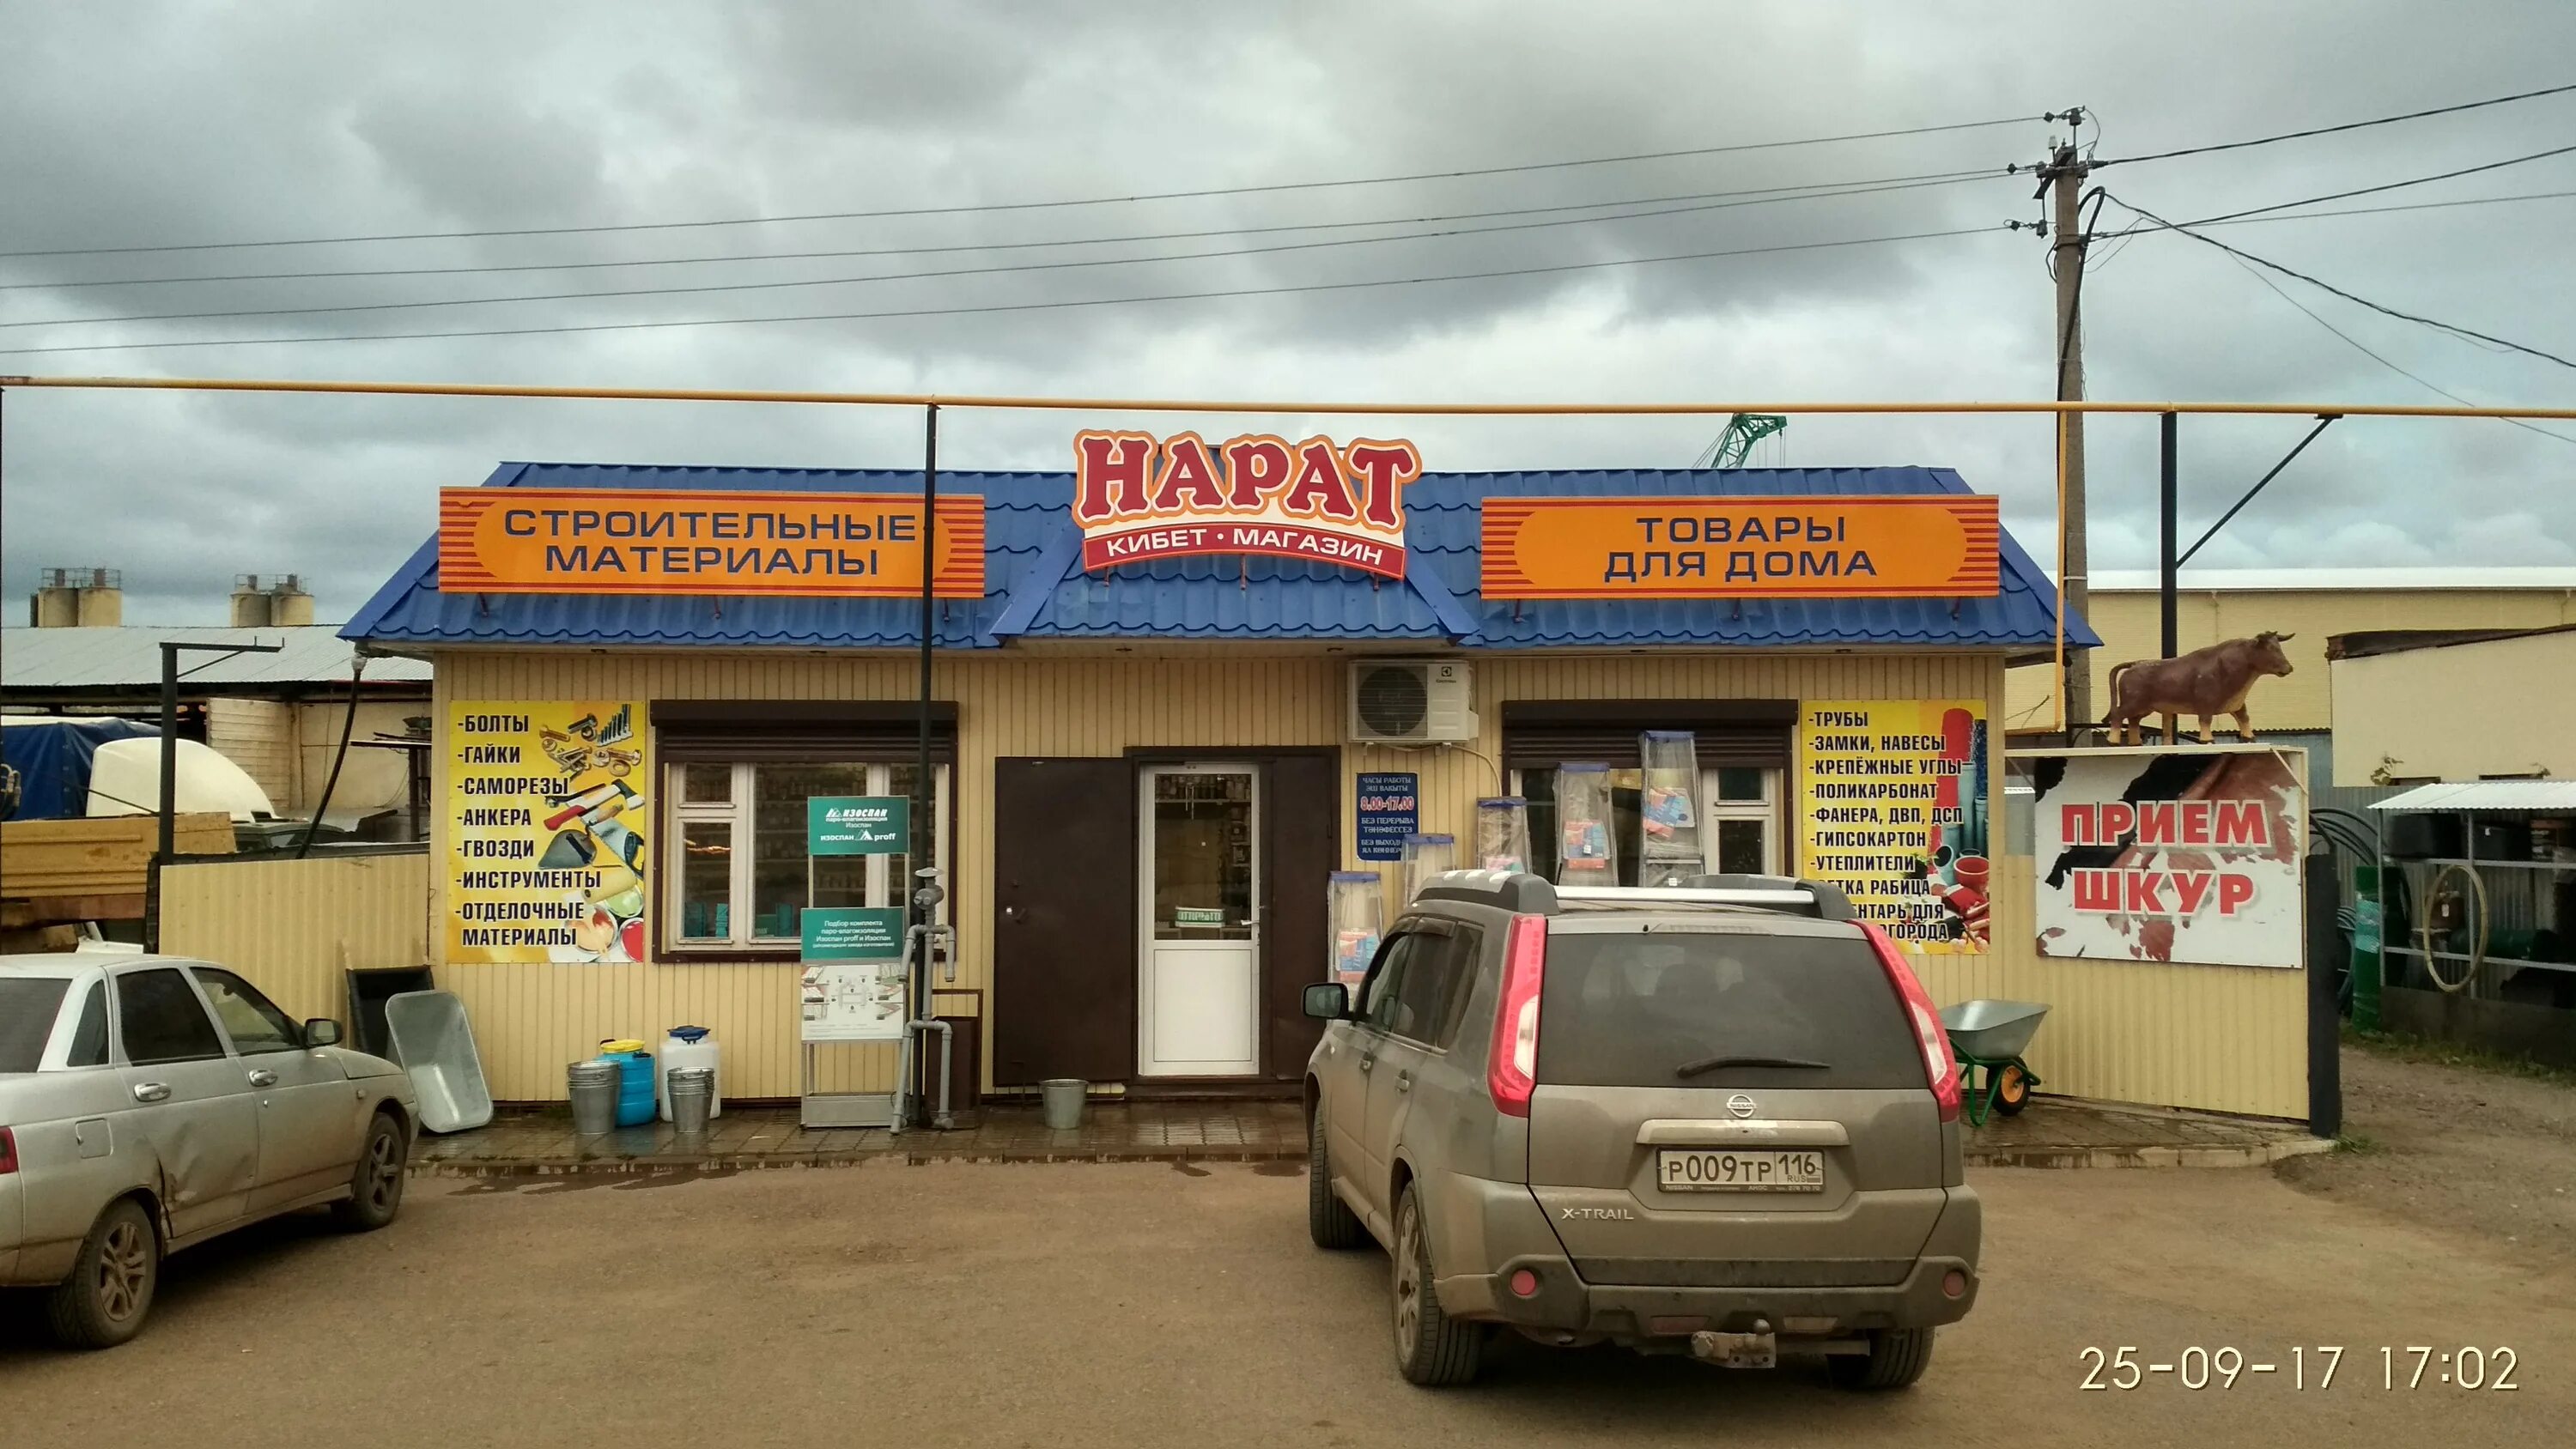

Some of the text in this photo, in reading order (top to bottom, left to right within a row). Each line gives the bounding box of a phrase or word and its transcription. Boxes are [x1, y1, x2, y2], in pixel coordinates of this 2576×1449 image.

[1079, 435, 1417, 529] НАРАТ
[504, 509, 916, 542] СТРОИТЕЛЬНЫЕ
[1637, 516, 1845, 543] ТОВАРЫ
[1106, 528, 1382, 566] КИБЕТ МАГАЗИН
[545, 545, 878, 575] МАТЕРИАЛЫ
[1604, 549, 1877, 583] ДЛЯ ДОМА
[458, 715, 529, 732] -БОЛТЫ
[1808, 712, 1868, 727] -ТРУБЫ
[1881, 735, 1946, 751] НАВЕСЫ
[458, 743, 520, 763] -ГАЙКИ
[1919, 759, 1962, 775] УГЛЫ
[457, 777, 568, 795] -САМОРЕЗЫ
[1809, 783, 1938, 798] -ПОЛИКАРБОНАТ
[1360, 796, 1414, 810] 8.00-17.00
[457, 809, 532, 826] -АНКЕРА
[843, 809, 888, 817] ИЗОСПАН
[1889, 807, 1926, 824] ДВП,
[1932, 807, 1963, 824] ДСП
[2061, 800, 2271, 847] ПРИЕМ
[874, 833, 896, 842] proff
[1810, 831, 1926, 847] -ГИПСОКАРТОН
[456, 840, 534, 859] -ГВОЗДИ
[1810, 855, 1915, 871] -УТЕПЛИТЕЛИ
[455, 870, 601, 888] -ИНСТРУМЕНТЫ
[1871, 880, 1929, 897] РАБИЦА
[2071, 868, 2257, 917] ШКУР
[455, 902, 584, 922] -ОТДЕЛОЧНЫЕ
[1913, 905, 1944, 921] ДЛЯ
[462, 928, 576, 945] МАТЕРИАЛЫ
[1778, 1154, 1816, 1175] 116
[1787, 1174, 1807, 1183] RUS
[1561, 1208, 1635, 1220] X-TRAIL
